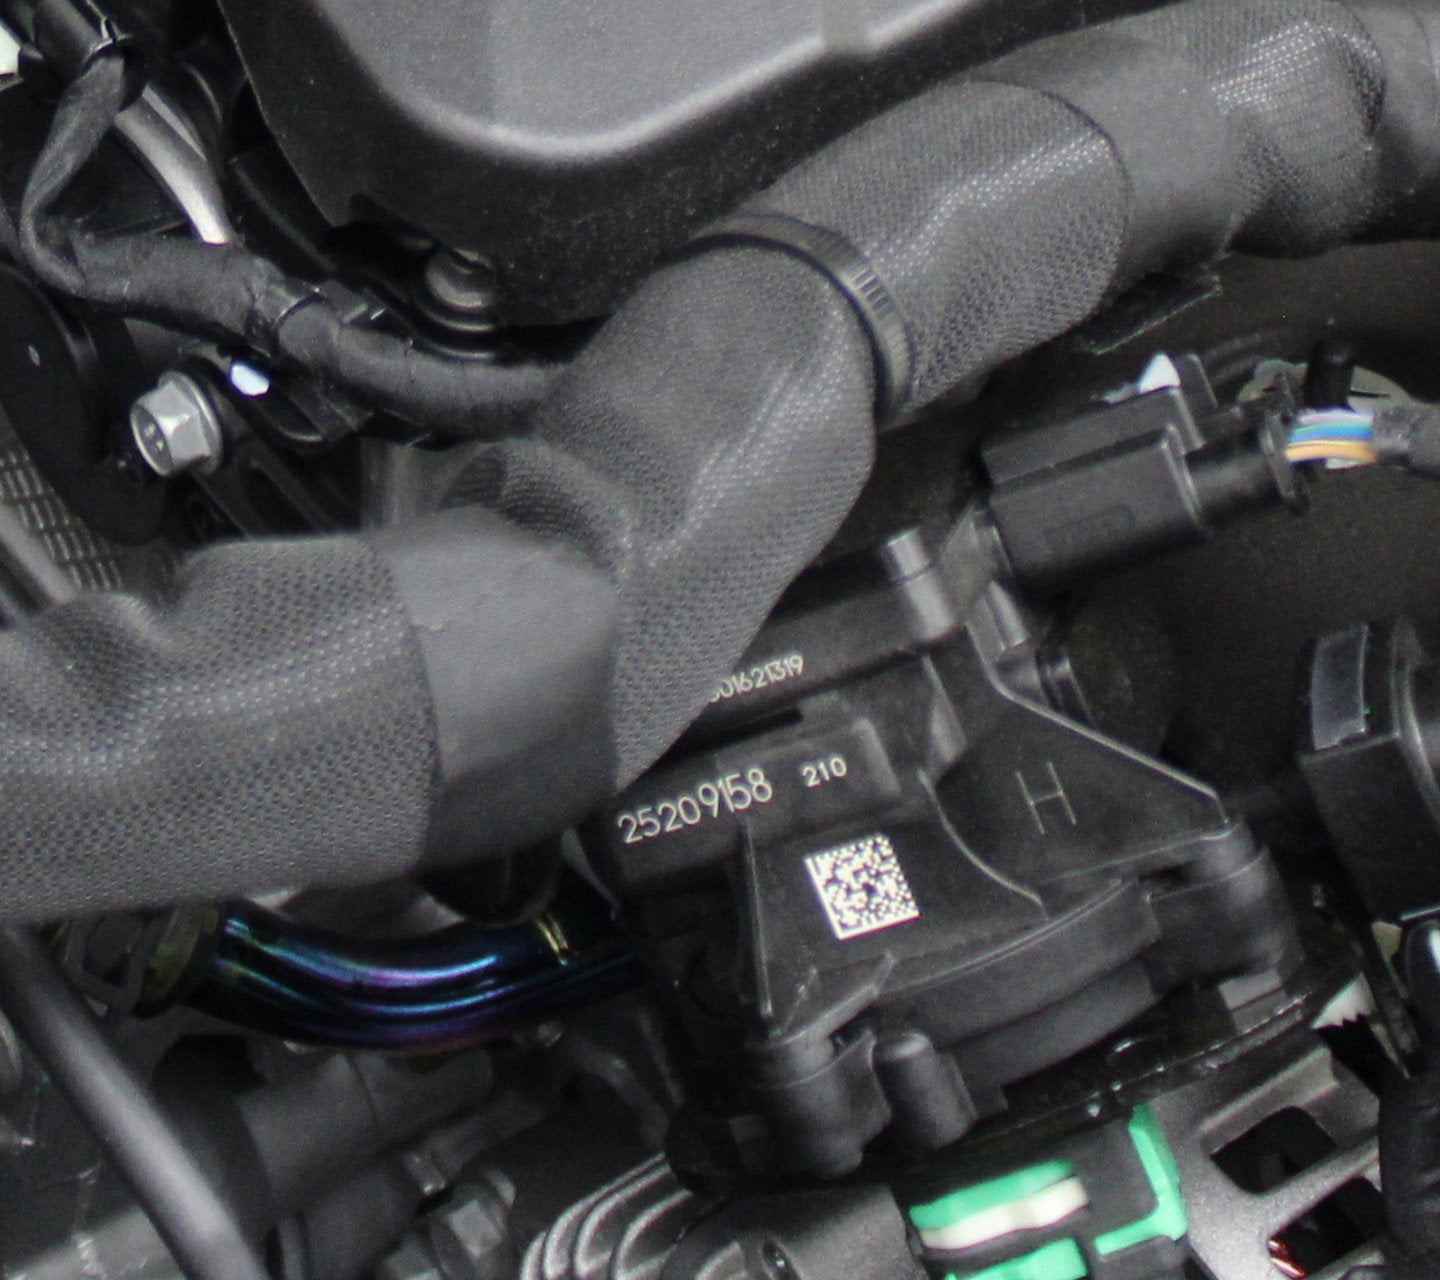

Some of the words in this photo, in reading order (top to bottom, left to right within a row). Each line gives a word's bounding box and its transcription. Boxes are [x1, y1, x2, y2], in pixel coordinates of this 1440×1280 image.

[617, 768, 773, 845] 25209158
[801, 756, 848, 788] 210
[1015, 761, 1077, 834] H
